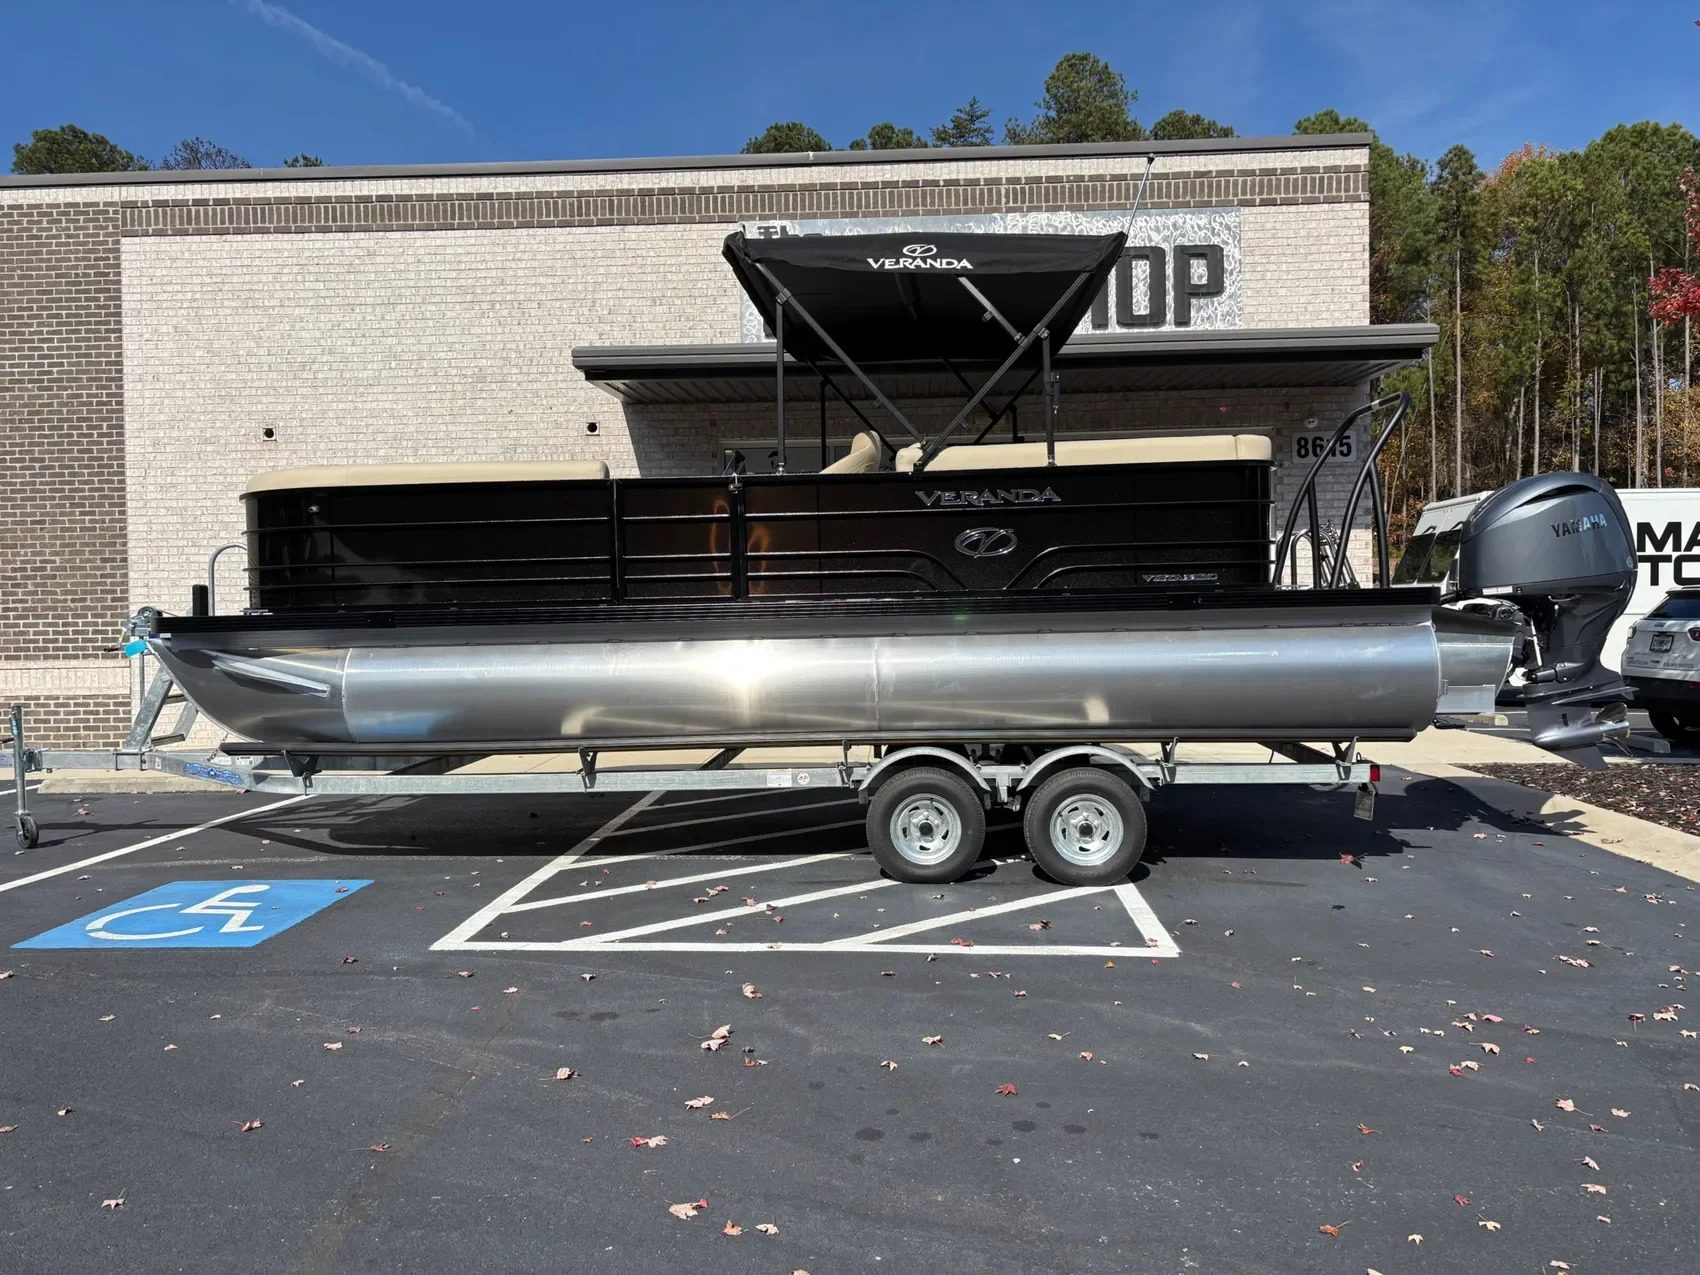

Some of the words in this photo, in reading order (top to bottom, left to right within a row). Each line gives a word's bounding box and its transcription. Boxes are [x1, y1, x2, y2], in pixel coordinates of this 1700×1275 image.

[866, 257, 974, 269] VERANDA
[915, 486, 1062, 506] VERANDA
[1550, 513, 1608, 538] YAMAHA
